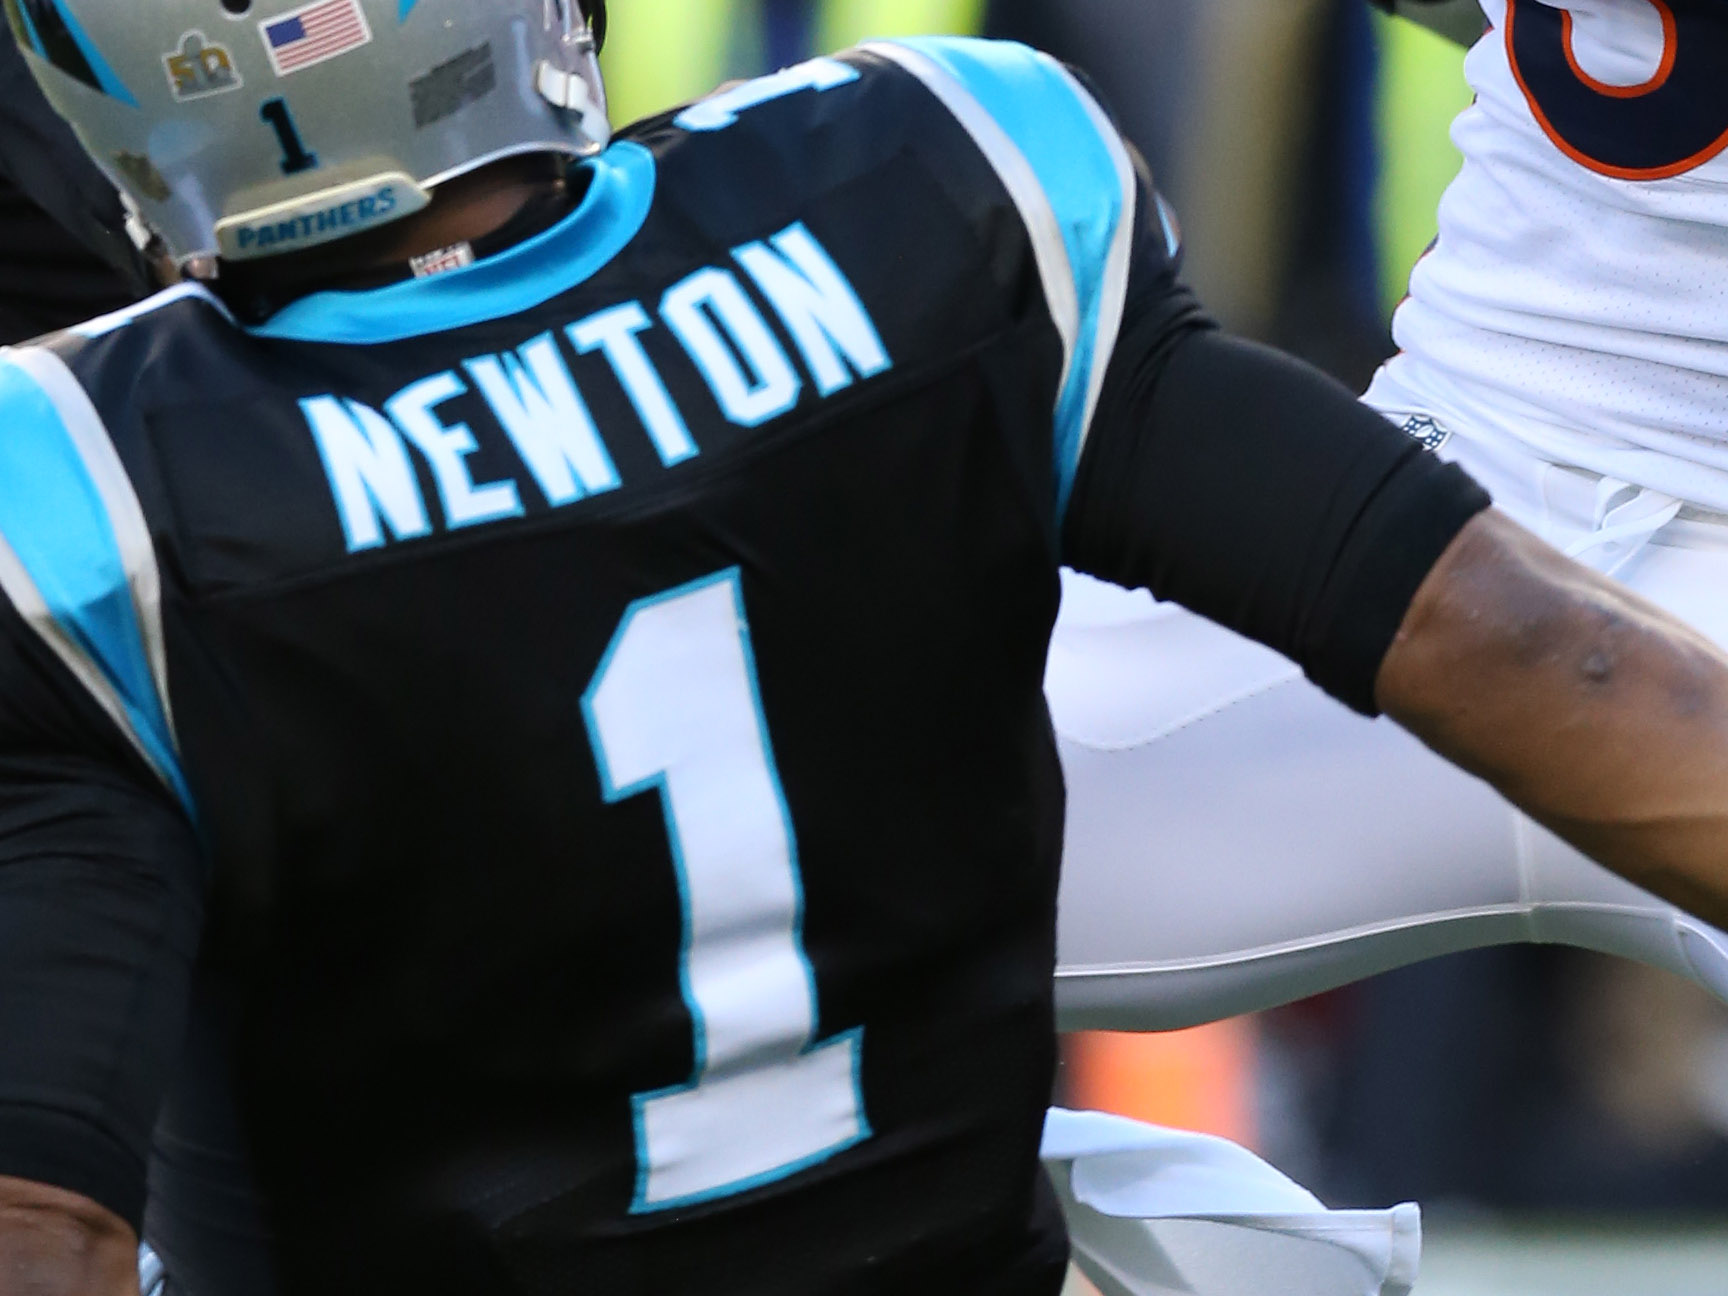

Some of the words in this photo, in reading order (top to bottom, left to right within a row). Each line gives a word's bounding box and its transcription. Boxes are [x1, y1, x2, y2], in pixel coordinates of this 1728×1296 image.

[237, 186, 398, 248] PANTHERS
[259, 97, 320, 175] 1
[299, 220, 893, 554] NEWTON
[580, 565, 875, 1215] 1
